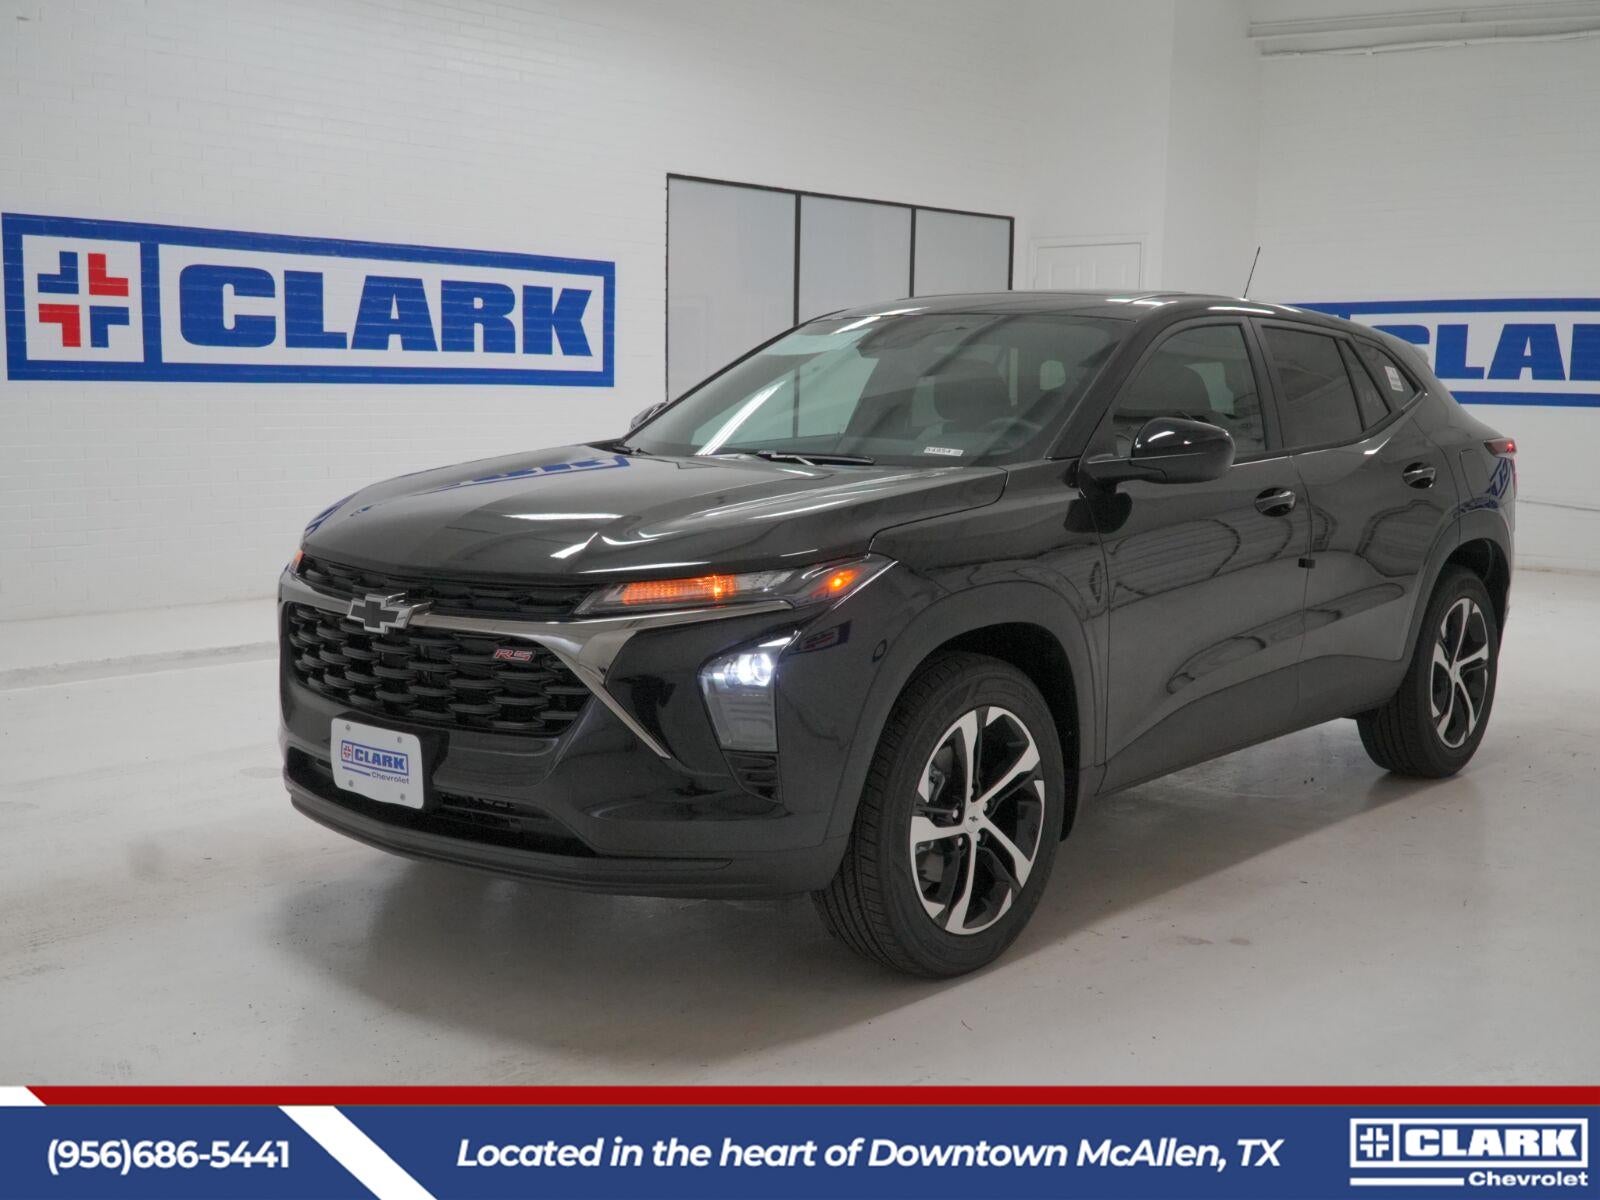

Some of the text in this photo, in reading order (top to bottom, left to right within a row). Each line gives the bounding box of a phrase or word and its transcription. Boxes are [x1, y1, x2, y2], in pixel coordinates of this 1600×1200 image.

[179, 264, 593, 357] CLARK
[495, 648, 533, 662] RS
[354, 748, 405, 770] CLARK
[371, 771, 410, 785] Chevrolet
